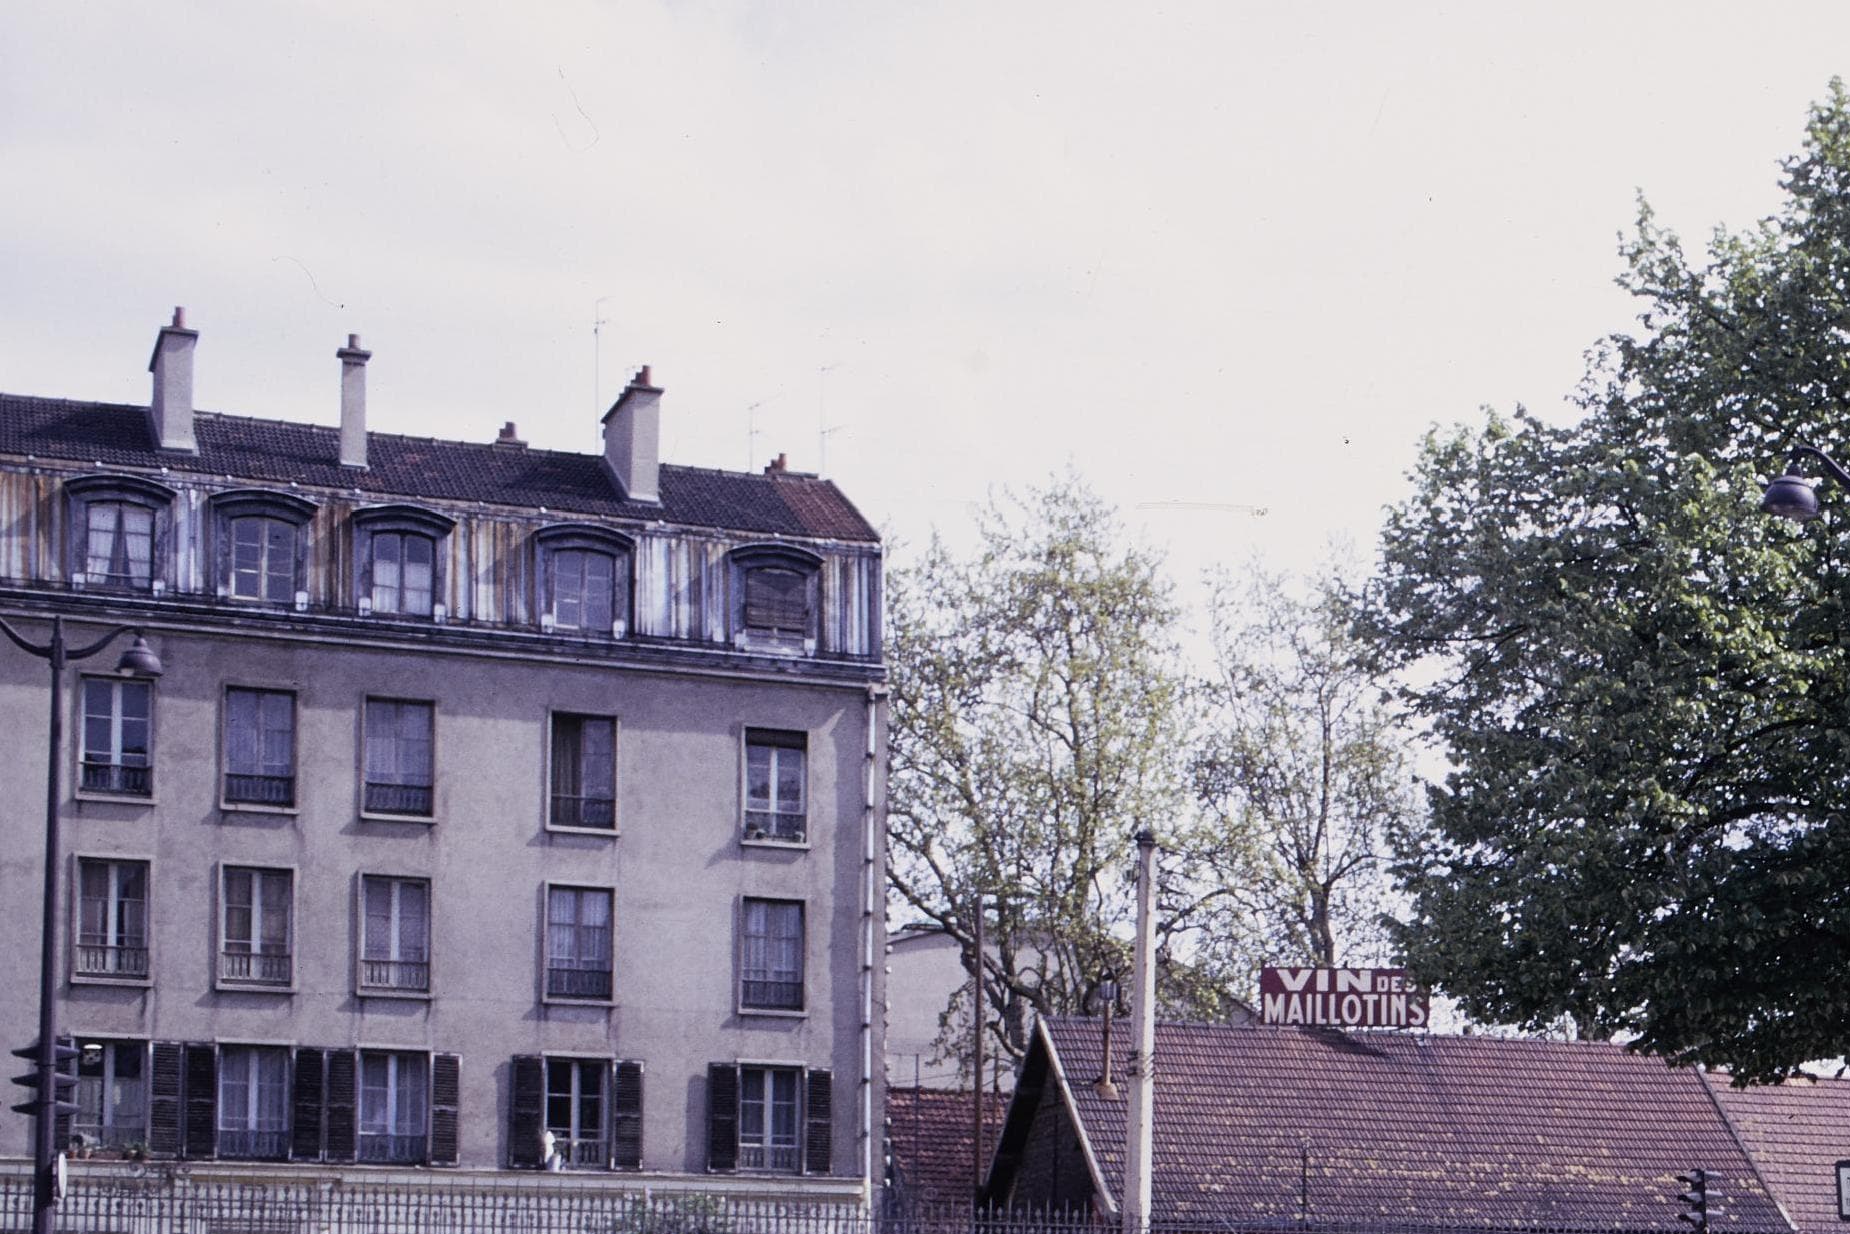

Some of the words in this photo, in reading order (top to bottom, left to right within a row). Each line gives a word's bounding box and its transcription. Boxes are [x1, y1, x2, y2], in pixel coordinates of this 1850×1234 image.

[1276, 969, 1372, 992] VIN
[1376, 975, 1417, 993] DES
[1263, 993, 1426, 1026] MAILLOTINS
